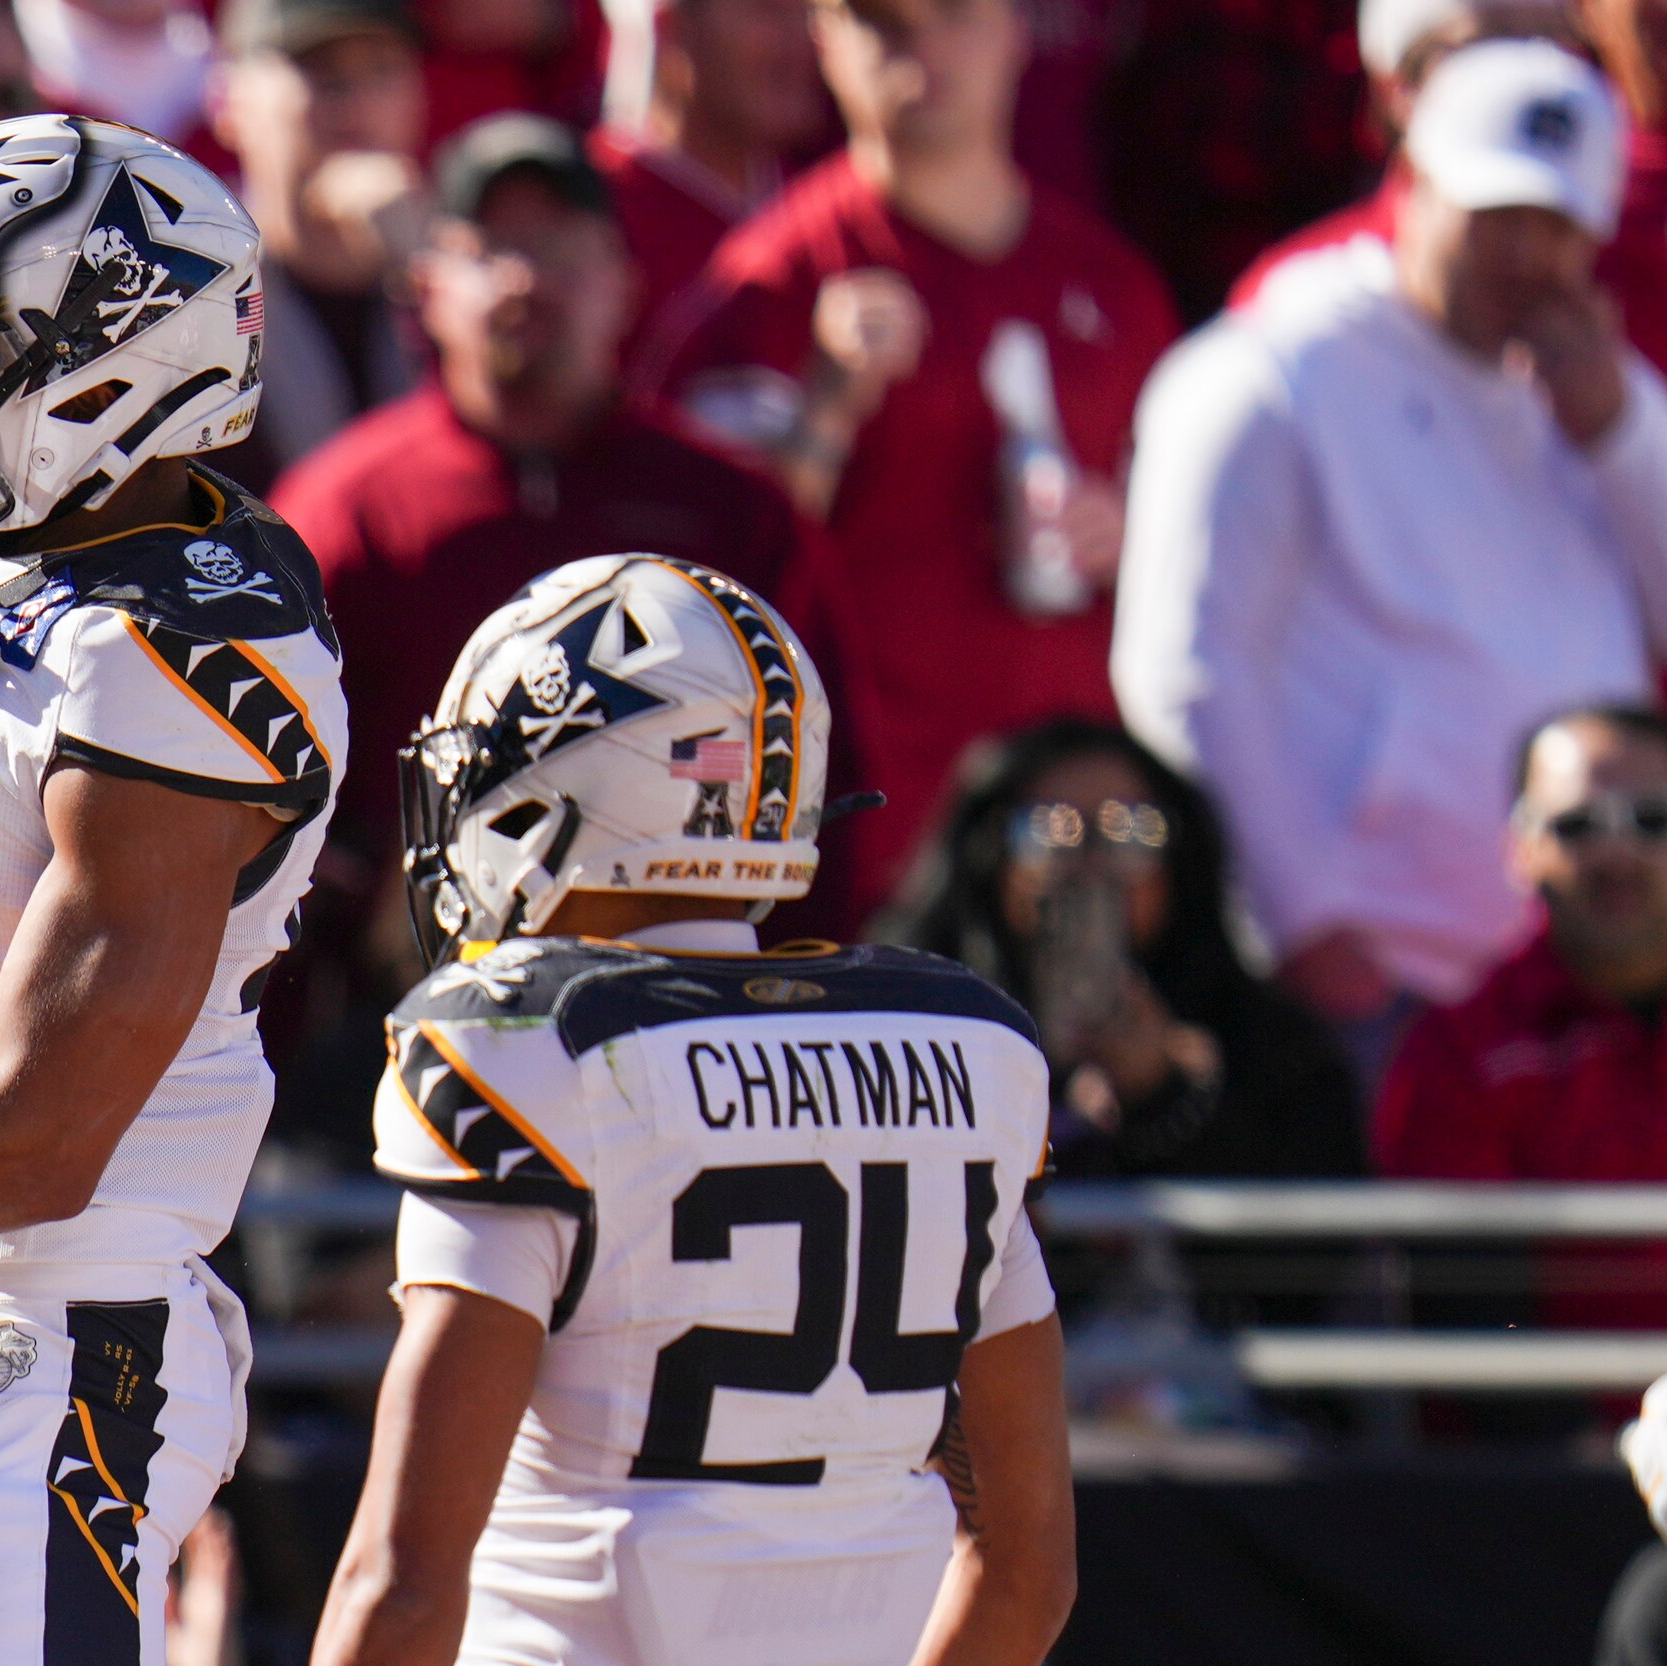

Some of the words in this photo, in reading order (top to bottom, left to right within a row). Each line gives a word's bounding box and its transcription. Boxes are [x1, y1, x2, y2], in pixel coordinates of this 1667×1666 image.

[644, 860, 724, 881] FEAR
[732, 860, 780, 881] THE
[686, 1039, 977, 1130] CHATMAN
[627, 1159, 1000, 1486] 24
[114, 1373, 127, 1406] JOLLY
